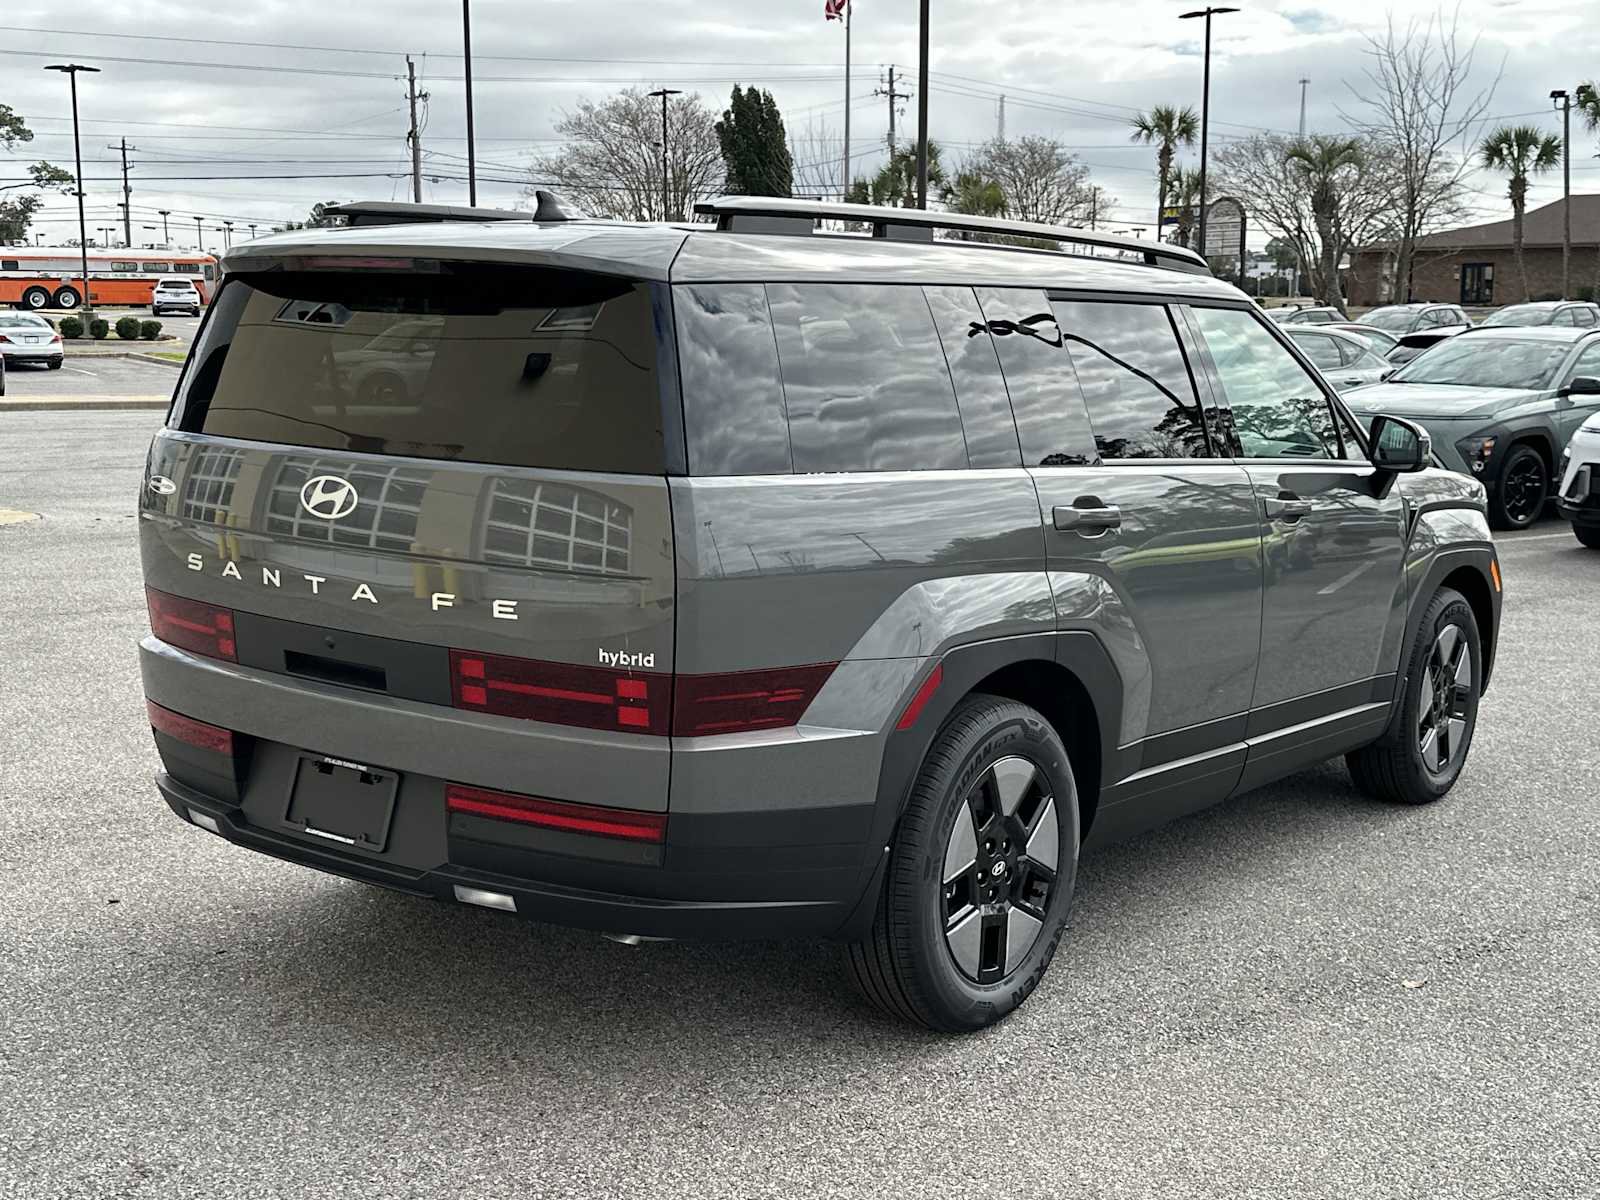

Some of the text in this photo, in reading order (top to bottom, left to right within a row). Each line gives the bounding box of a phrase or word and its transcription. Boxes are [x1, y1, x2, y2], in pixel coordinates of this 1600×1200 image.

[187, 553, 518, 620] SANTA FE
[599, 648, 655, 668] hybrid
